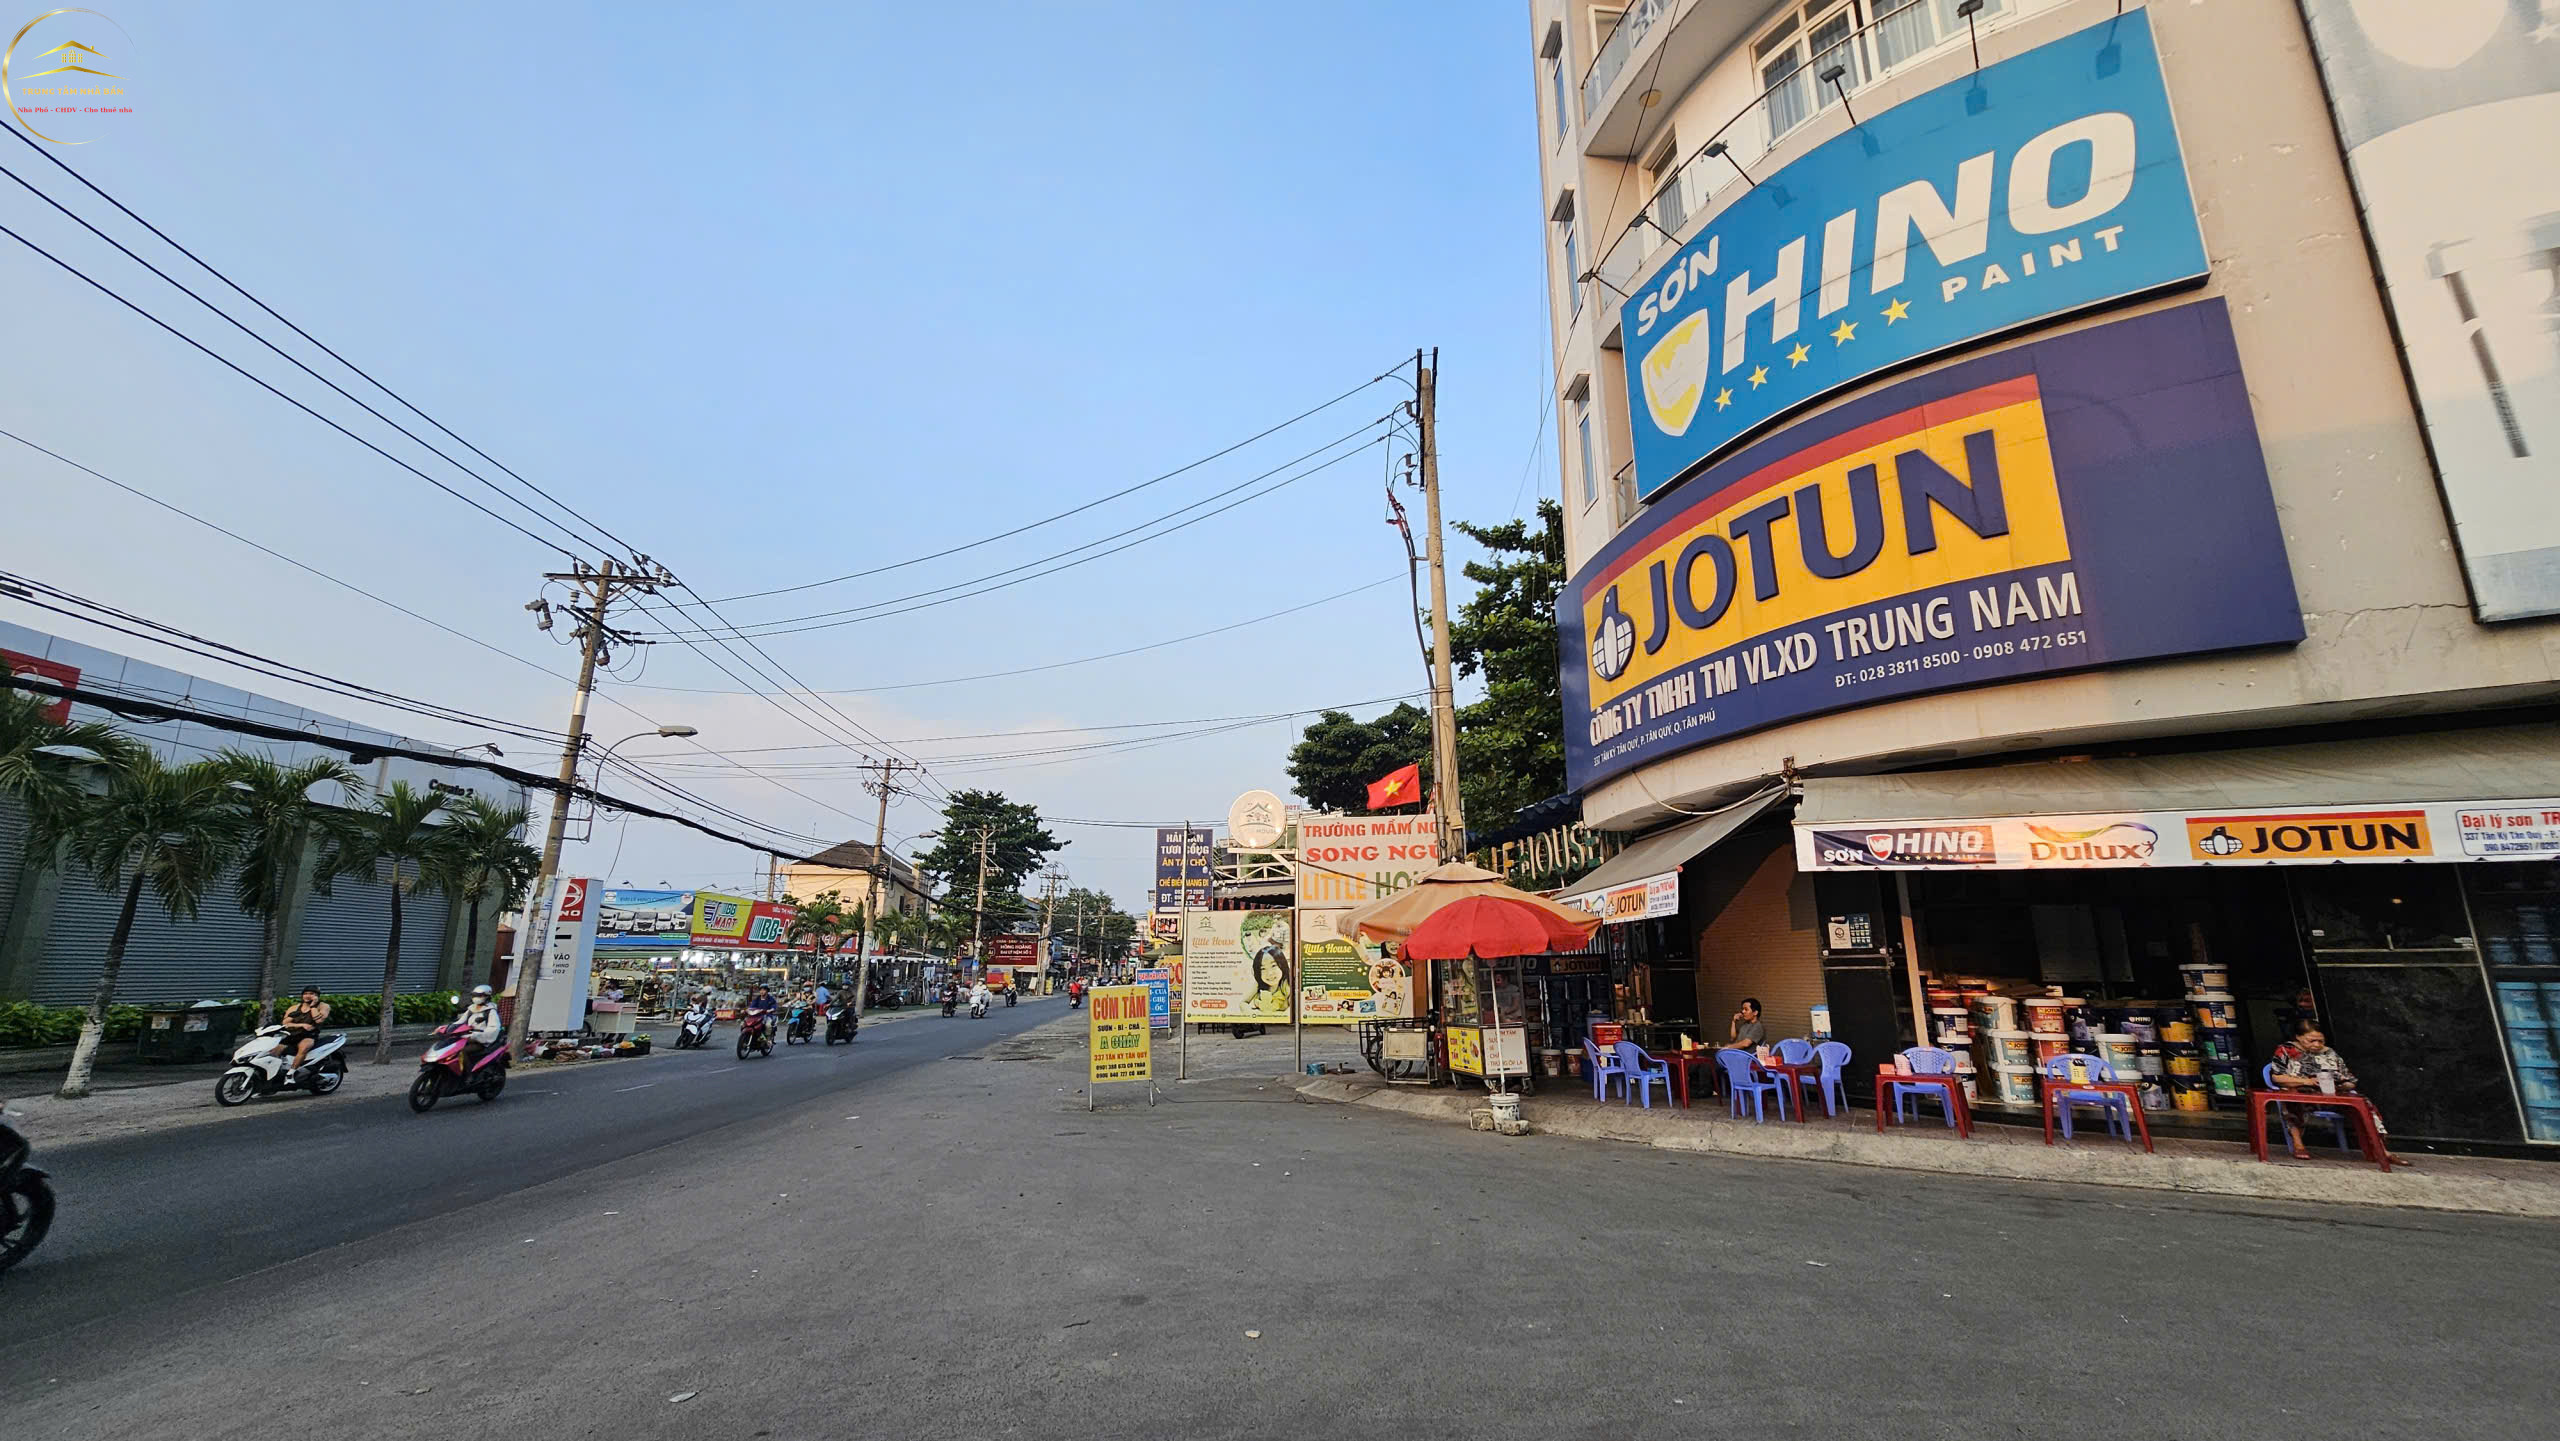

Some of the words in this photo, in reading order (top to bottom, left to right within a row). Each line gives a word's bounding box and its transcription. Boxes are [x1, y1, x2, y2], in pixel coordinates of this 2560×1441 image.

[1722, 111, 2137, 376] HINO
[1941, 225, 2125, 303] PAINT
[1637, 235, 1719, 337] SƠN
[1643, 429, 2010, 656] JOTUN
[1590, 706, 1623, 747] CÔNG
[1622, 693, 1642, 730] TY
[1646, 671, 1697, 719] TNHH
[1700, 656, 1738, 699] TM
[1742, 632, 1818, 685] VLXD
[1825, 596, 1955, 662] TRUNG
[1969, 571, 2083, 632] NAM
[1835, 673, 1857, 688] ĐT:
[1860, 666, 1885, 683] 028
[1888, 658, 1919, 677] 3811
[1922, 650, 1961, 669] 8500
[1972, 641, 2015, 660] 0908
[2019, 635, 2052, 652] 472
[2056, 630, 2088, 648] 651
[1646, 730, 1658, 743] TÂN
[1673, 722, 1682, 733] Q.
[1681, 716, 1698, 730] TÂN
[1699, 707, 1716, 725] PHÚ
[1304, 822, 1366, 838] TRƯỜNG
[1371, 819, 1411, 836] MẦM
[1417, 821, 1438, 835] NO
[2462, 814, 2486, 831] Đại
[2489, 813, 2502, 829] lý
[2540, 811, 2560, 826] TR
[1166, 832, 1182, 843] HẢI
[1896, 831, 1984, 854] HINO
[2250, 823, 2421, 854] JOTUN
[2464, 832, 2479, 840] 337
[1306, 846, 1380, 862] SONG
[1517, 821, 1605, 880] HOUSE
[1823, 848, 1864, 863] SƠN
[2029, 841, 2144, 862] Dulux
[1303, 872, 1367, 901] LITTLE
[1615, 892, 1646, 915] JOTUN
[1212, 935, 1235, 947] House
[1303, 943, 1324, 956] Little
[1325, 943, 1352, 954] House
[1093, 994, 1119, 1020] CƠM
[1122, 988, 1147, 1018] TẤM
[1100, 1035, 1109, 1049] A
